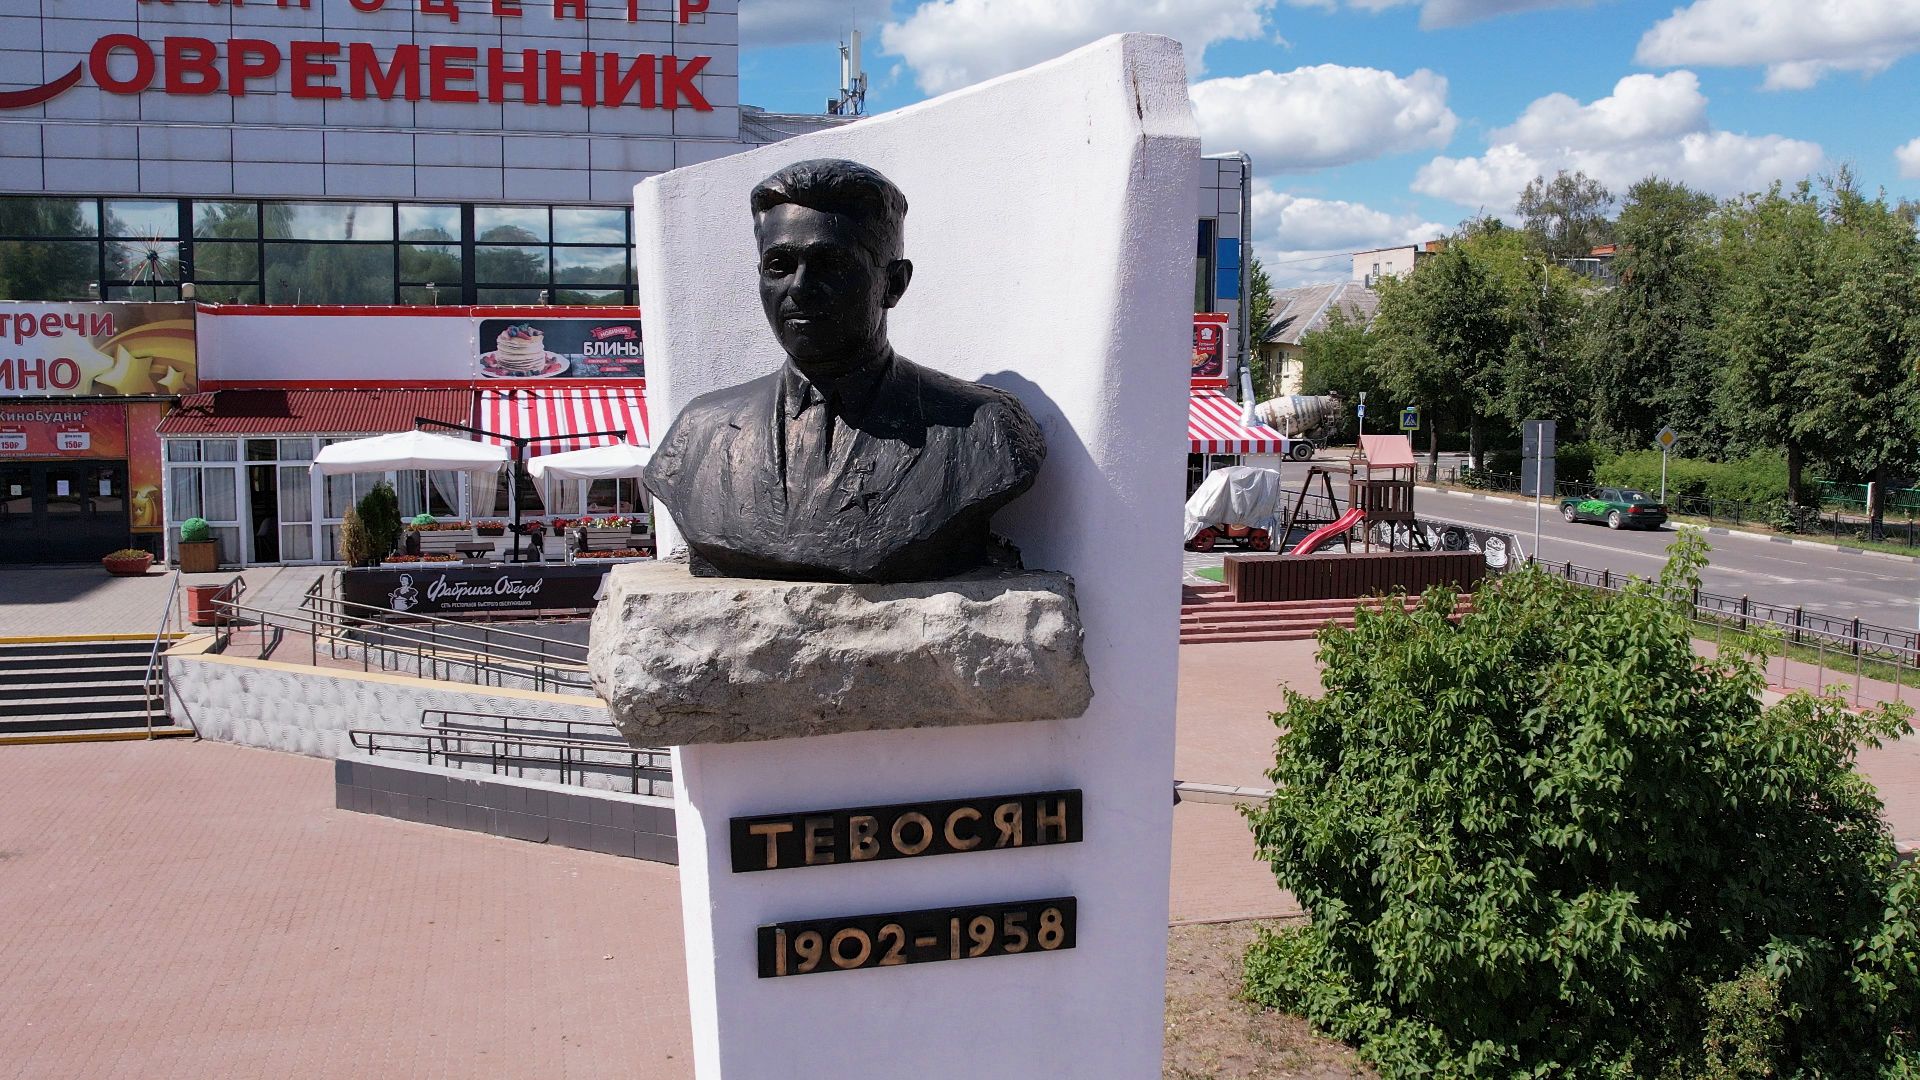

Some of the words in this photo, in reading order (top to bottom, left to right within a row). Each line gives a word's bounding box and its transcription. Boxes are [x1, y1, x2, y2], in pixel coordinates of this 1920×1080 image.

[0, 33, 714, 112] ОВРЕМЕННИК
[583, 341, 643, 356] БЛИНЫ
[427, 574, 493, 602] Фабрика
[494, 575, 543, 600] Обедов
[749, 798, 1067, 869] ТЕВОСЯН
[775, 906, 1065, 977] 1902-1958
